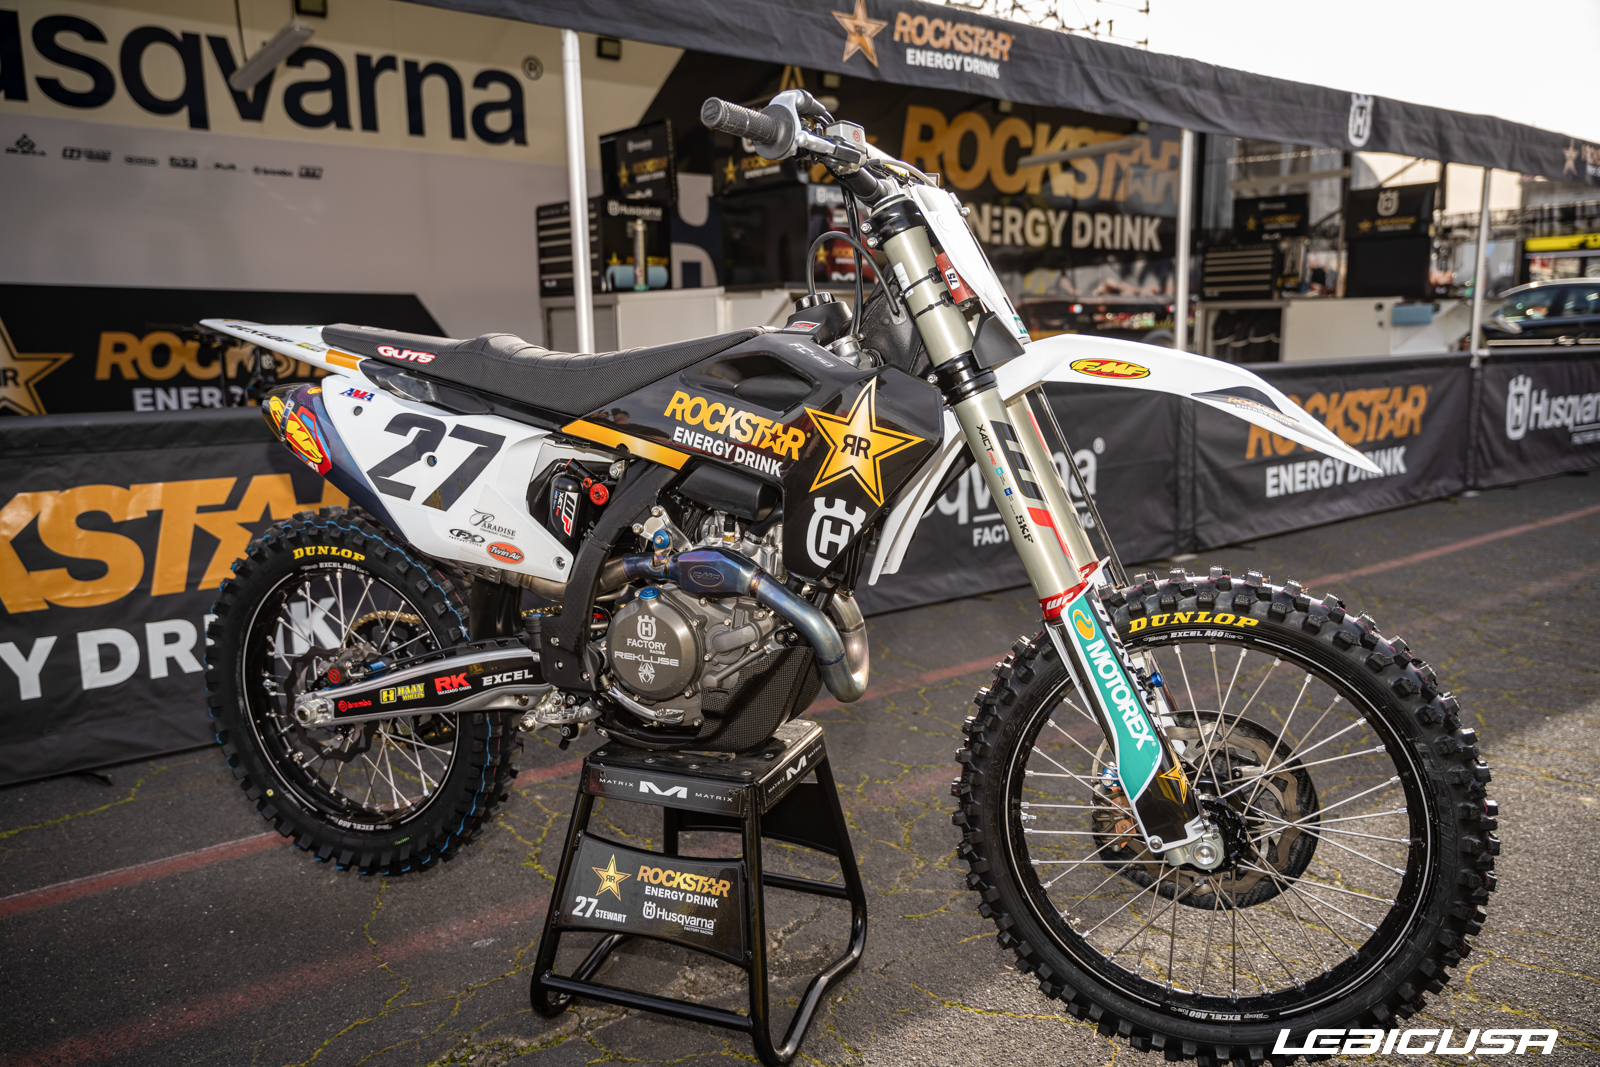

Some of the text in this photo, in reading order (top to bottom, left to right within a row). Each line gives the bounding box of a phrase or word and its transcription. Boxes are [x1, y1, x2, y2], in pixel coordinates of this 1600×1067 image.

[893, 11, 1012, 61] ROCKSTAR
[906, 48, 1000, 79] ENERGY DRINK
[0, 9, 529, 147] sqvarna
[966, 203, 1162, 252] NERGY DRINK
[377, 345, 435, 364] GUTS
[339, 387, 375, 402] AMA
[664, 390, 806, 460] ROCKSTAR
[976, 423, 995, 452] XACT
[366, 413, 506, 511] 27
[673, 426, 783, 478] ENERGY DRINK
[1266, 458, 1348, 498] ENERGY
[469, 508, 516, 537] PARADISE
[1015, 515, 1034, 543] SKF
[292, 546, 366, 561] DUNLOP
[490, 545, 523, 561] Twin Air
[1046, 592, 1074, 611] WP
[1129, 611, 1259, 633] DUNLOP
[627, 638, 667, 651] FACTORY
[1170, 630, 1203, 639] EXCEL
[1203, 630, 1225, 638] A60
[614, 651, 679, 667] REKLUSE
[397, 683, 425, 697] HAAN
[434, 672, 472, 692] RK
[482, 669, 533, 687] EXCEL
[348, 698, 372, 709] brembo
[402, 692, 424, 701] WHEELS
[1086, 638, 1155, 751] MOTOREX
[599, 777, 634, 788] MATRIX
[695, 792, 733, 802] MATRIX
[637, 865, 731, 898] ROCKSTAR
[644, 885, 719, 909] ENERGY DRINK
[572, 895, 627, 924] 27 STEWART
[656, 907, 714, 929] Husqvarna
